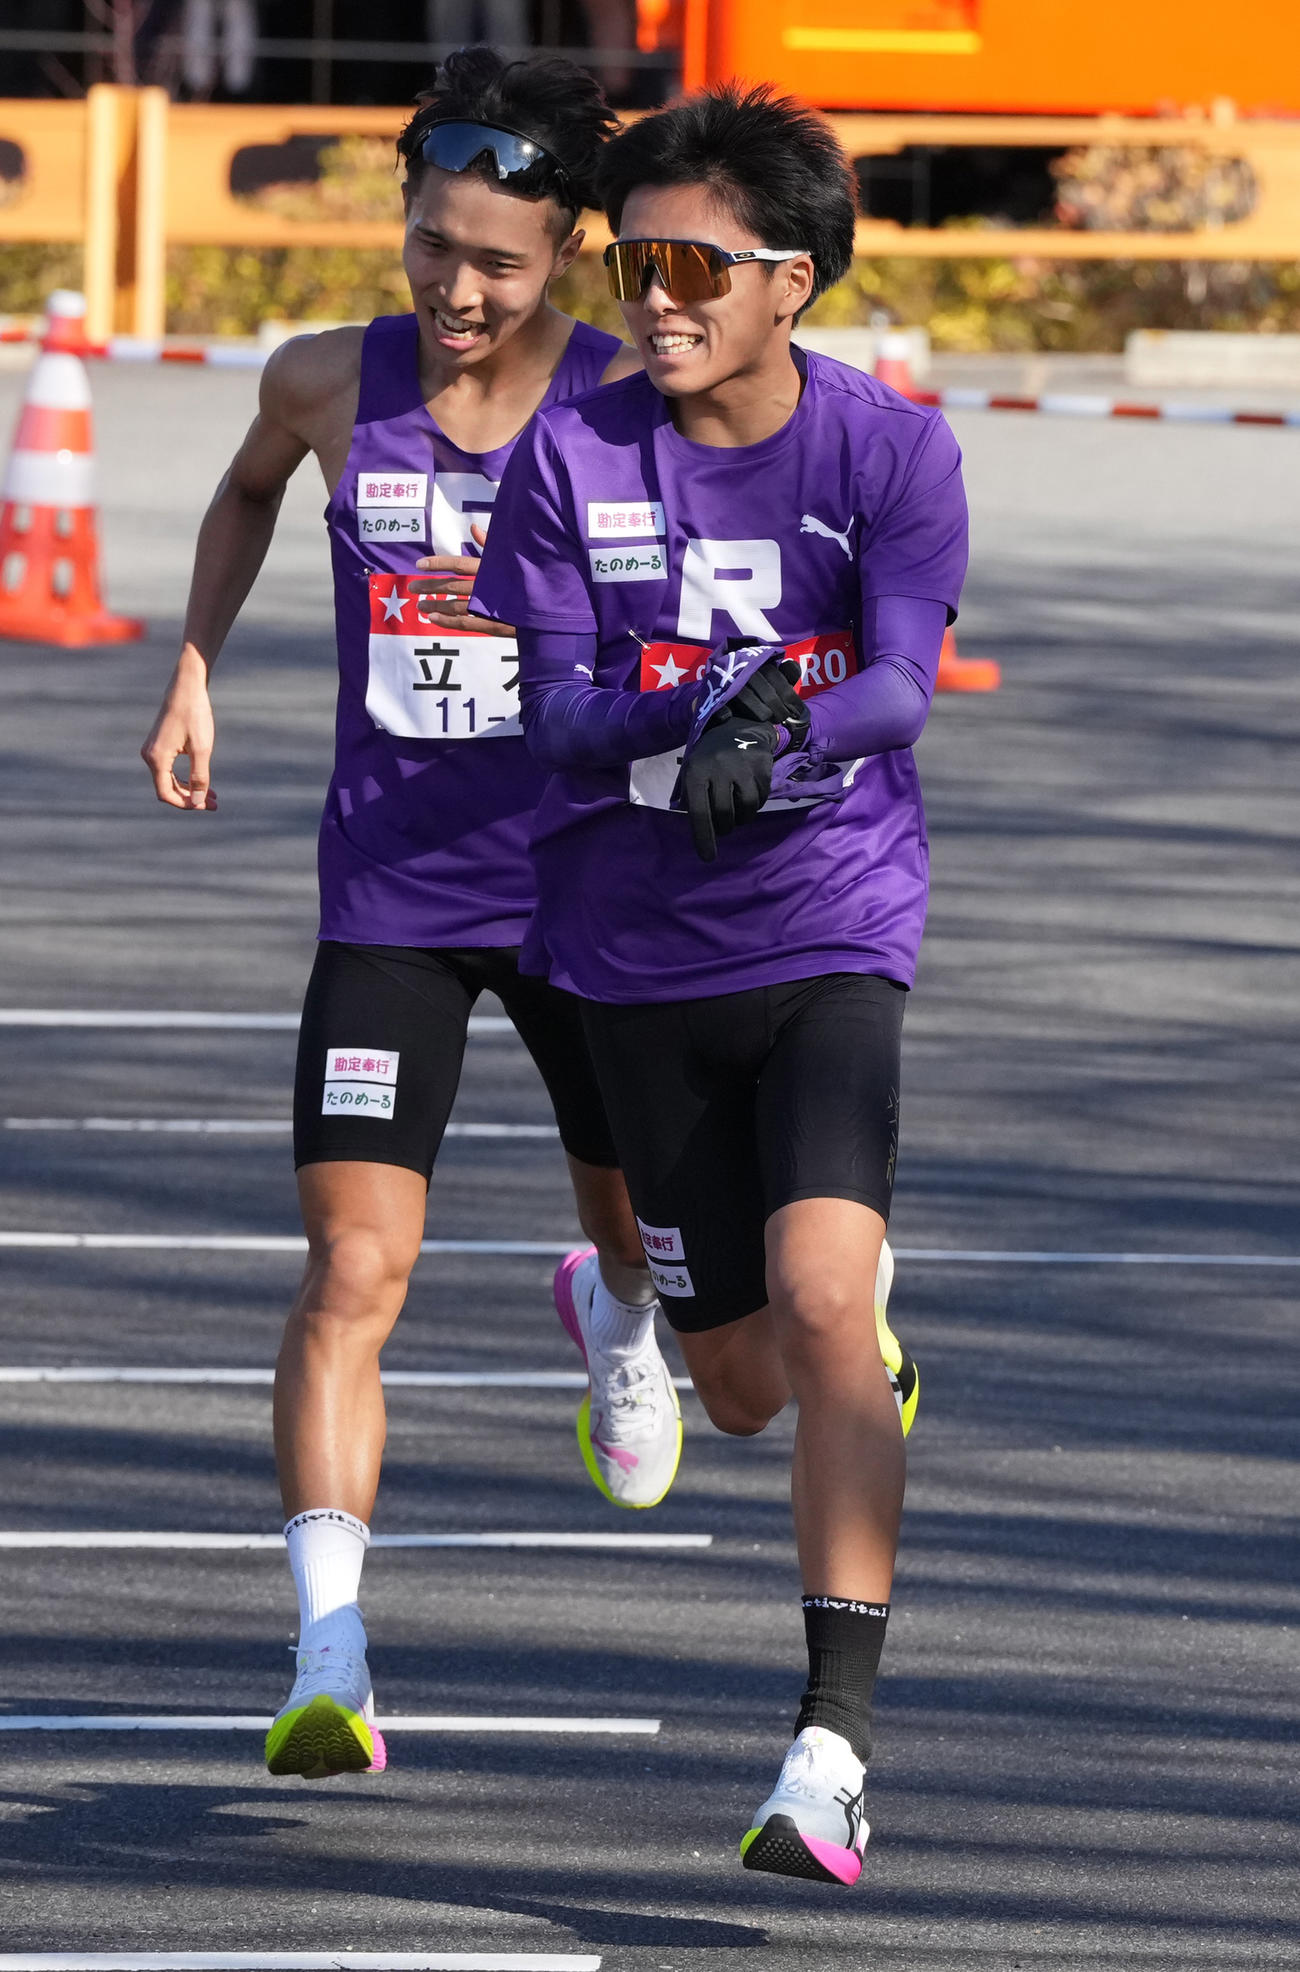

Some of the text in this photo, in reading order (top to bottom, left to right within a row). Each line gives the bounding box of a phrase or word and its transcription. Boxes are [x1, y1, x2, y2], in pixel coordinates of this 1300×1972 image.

[362, 518, 421, 533] たのめーる
[594, 555, 662, 573] たのめーる
[677, 538, 782, 642] R
[326, 1091, 392, 1109] たのめーる
[641, 1228, 675, 1252] 定奉行
[652, 1270, 688, 1289] のめーる
